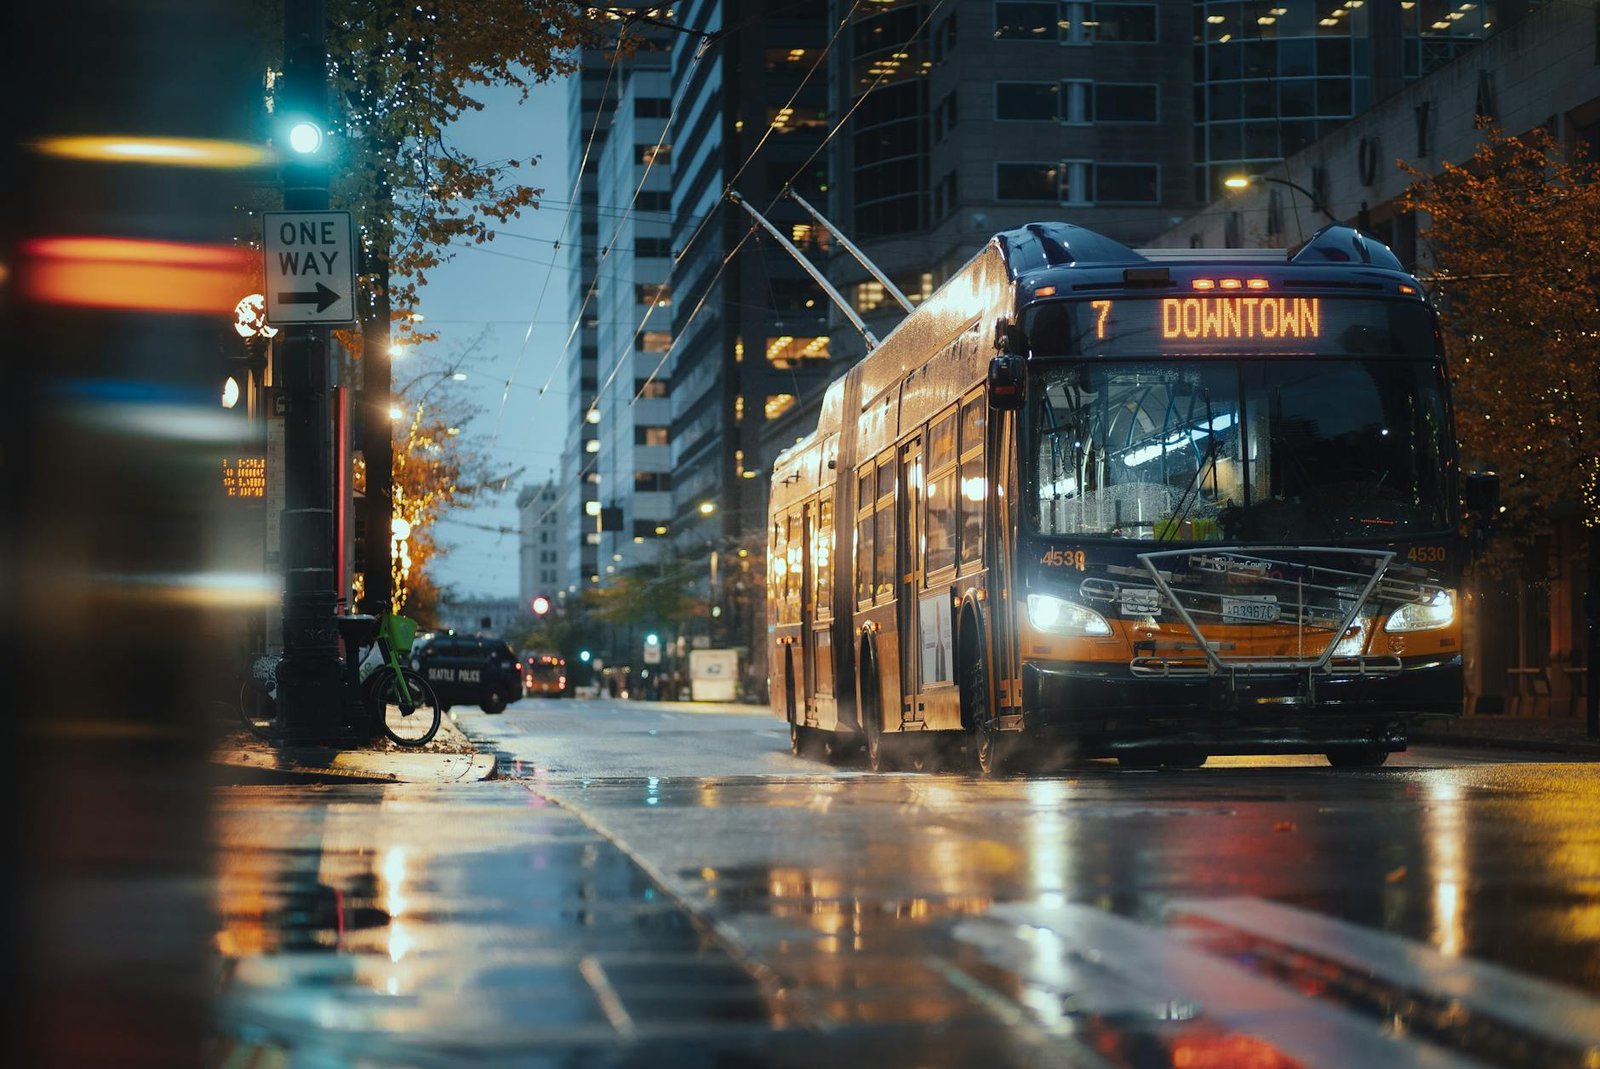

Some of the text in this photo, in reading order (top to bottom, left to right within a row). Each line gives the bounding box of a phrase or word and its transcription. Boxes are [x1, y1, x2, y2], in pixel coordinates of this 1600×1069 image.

[279, 221, 336, 245] ONE
[279, 251, 339, 276] WAY
[1091, 298, 1319, 339] 7 DOWNTOWN
[1042, 550, 1086, 567] 4530
[1408, 546, 1447, 562] 4530
[428, 667, 481, 683] SEATTLE POLICE
